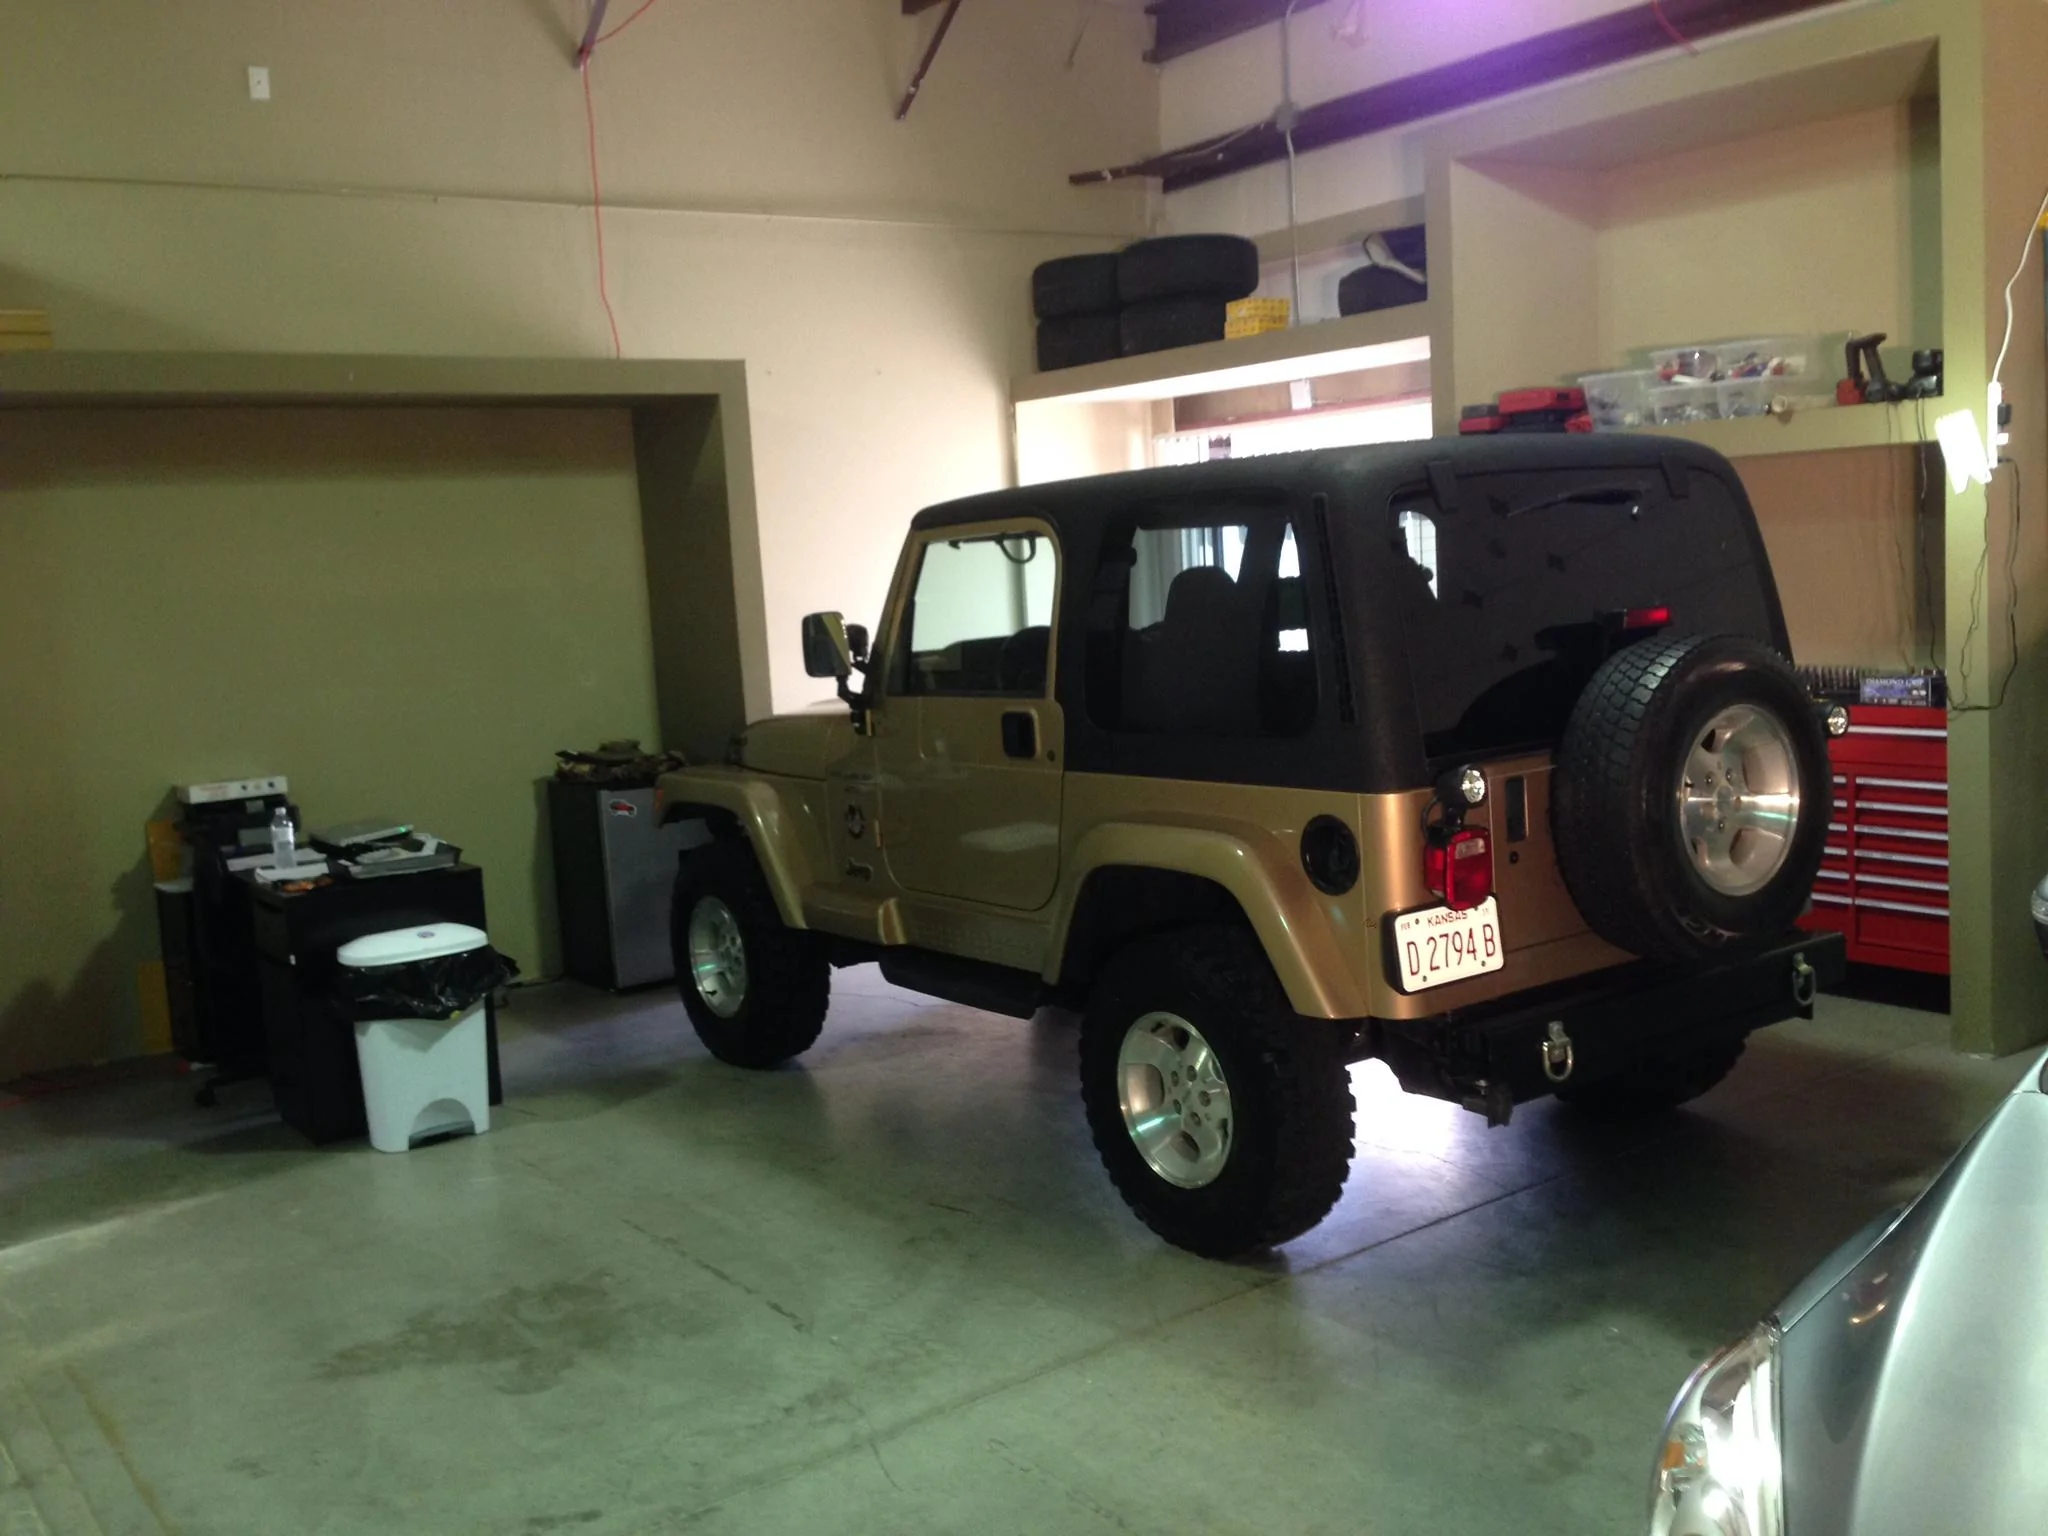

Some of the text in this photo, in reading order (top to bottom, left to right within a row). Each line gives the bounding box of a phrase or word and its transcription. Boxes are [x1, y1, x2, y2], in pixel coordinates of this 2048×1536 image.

[1427, 911, 1468, 928] KANSAS
[1406, 923, 1496, 976] D 2794 B
